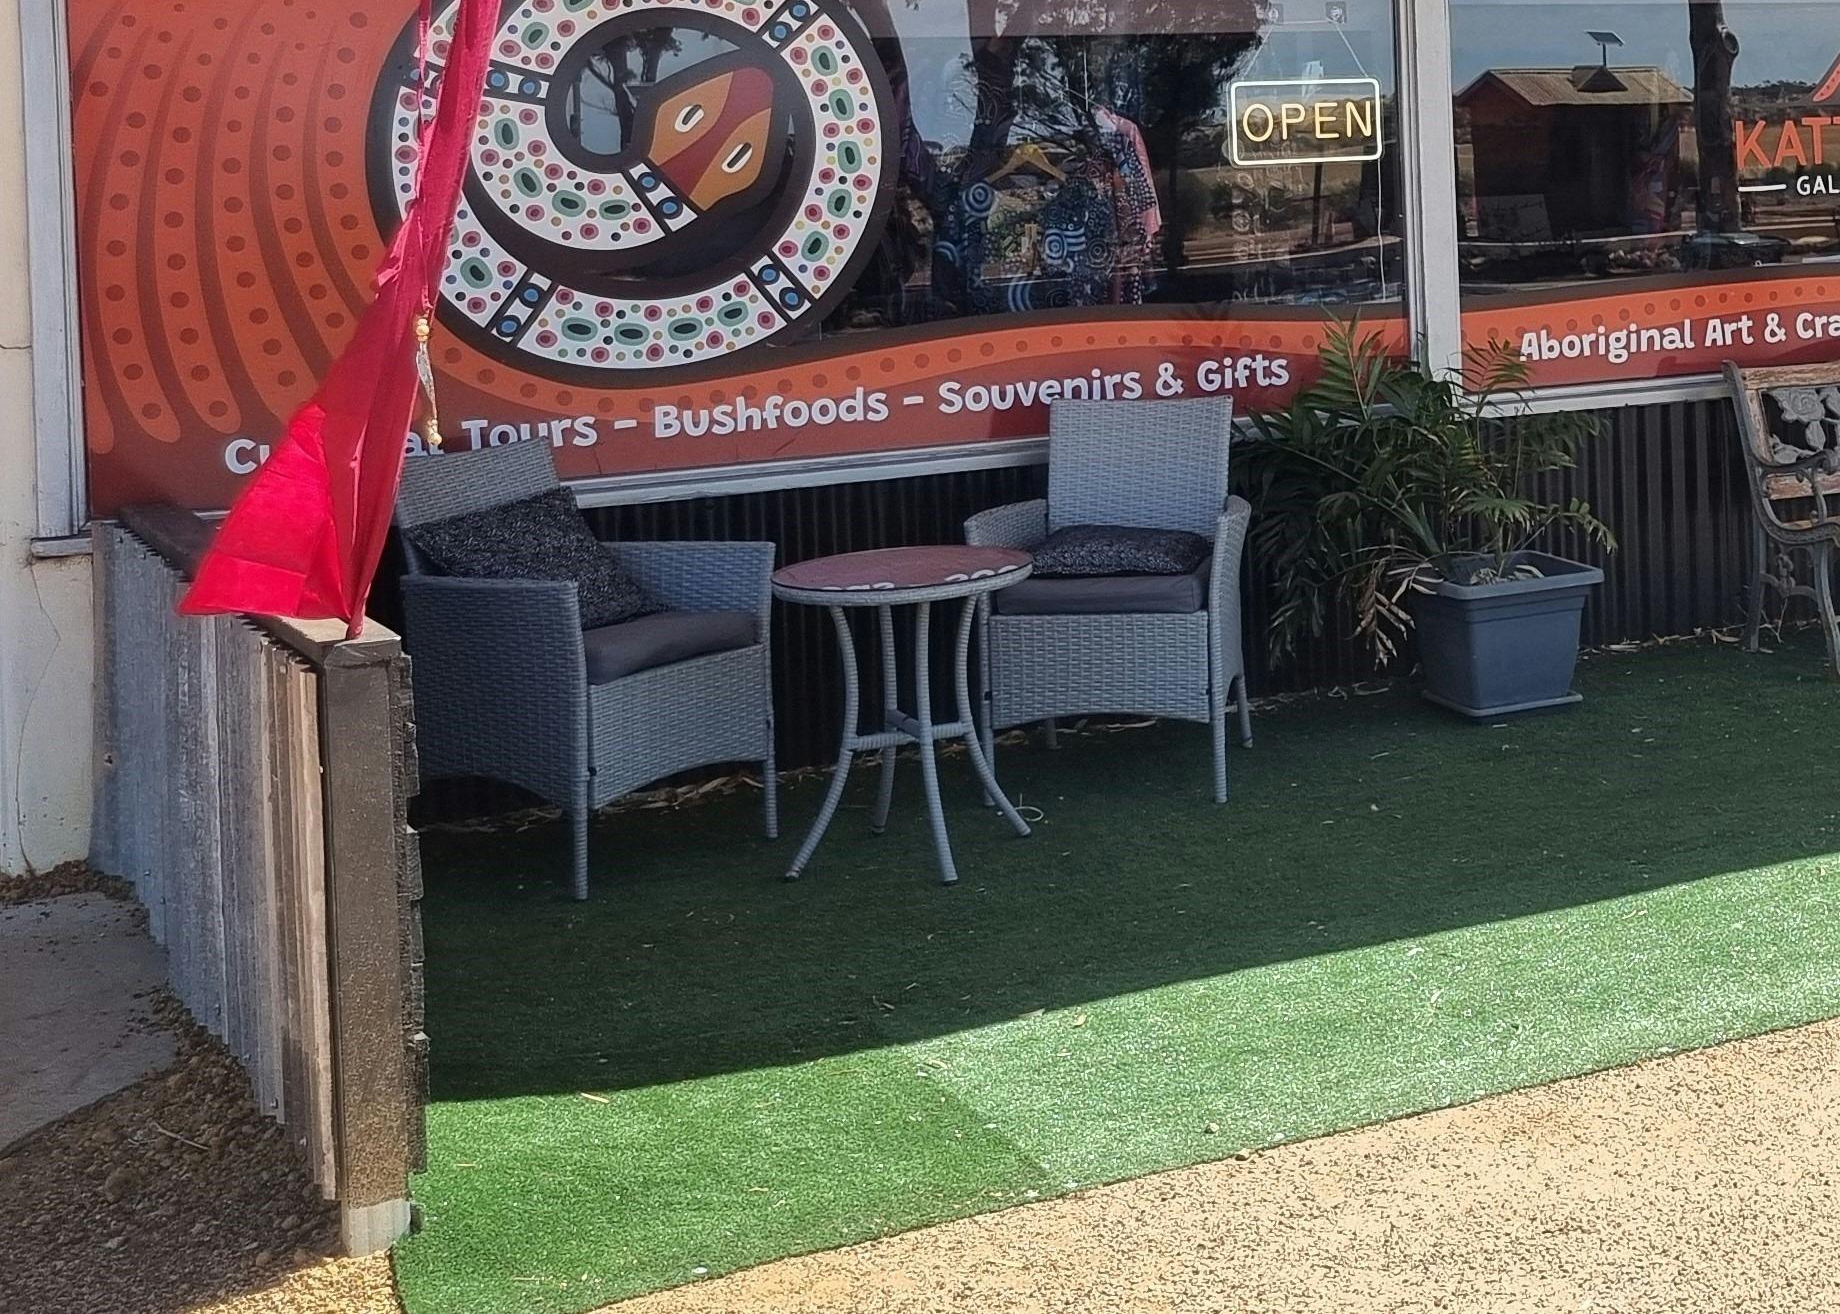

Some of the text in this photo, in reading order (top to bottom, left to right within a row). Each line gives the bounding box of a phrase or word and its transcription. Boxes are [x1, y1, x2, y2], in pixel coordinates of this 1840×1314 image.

[1242, 100, 1373, 142] OPEN
[1519, 319, 1695, 363] Aboriginal
[1705, 314, 1754, 347] Art
[1764, 313, 1787, 343] &
[461, 416, 598, 452] Tours
[654, 387, 889, 439] Bushfoods
[938, 368, 1142, 414] Souvenirs
[1155, 362, 1185, 397] &
[1197, 352, 1290, 391] Gifts
